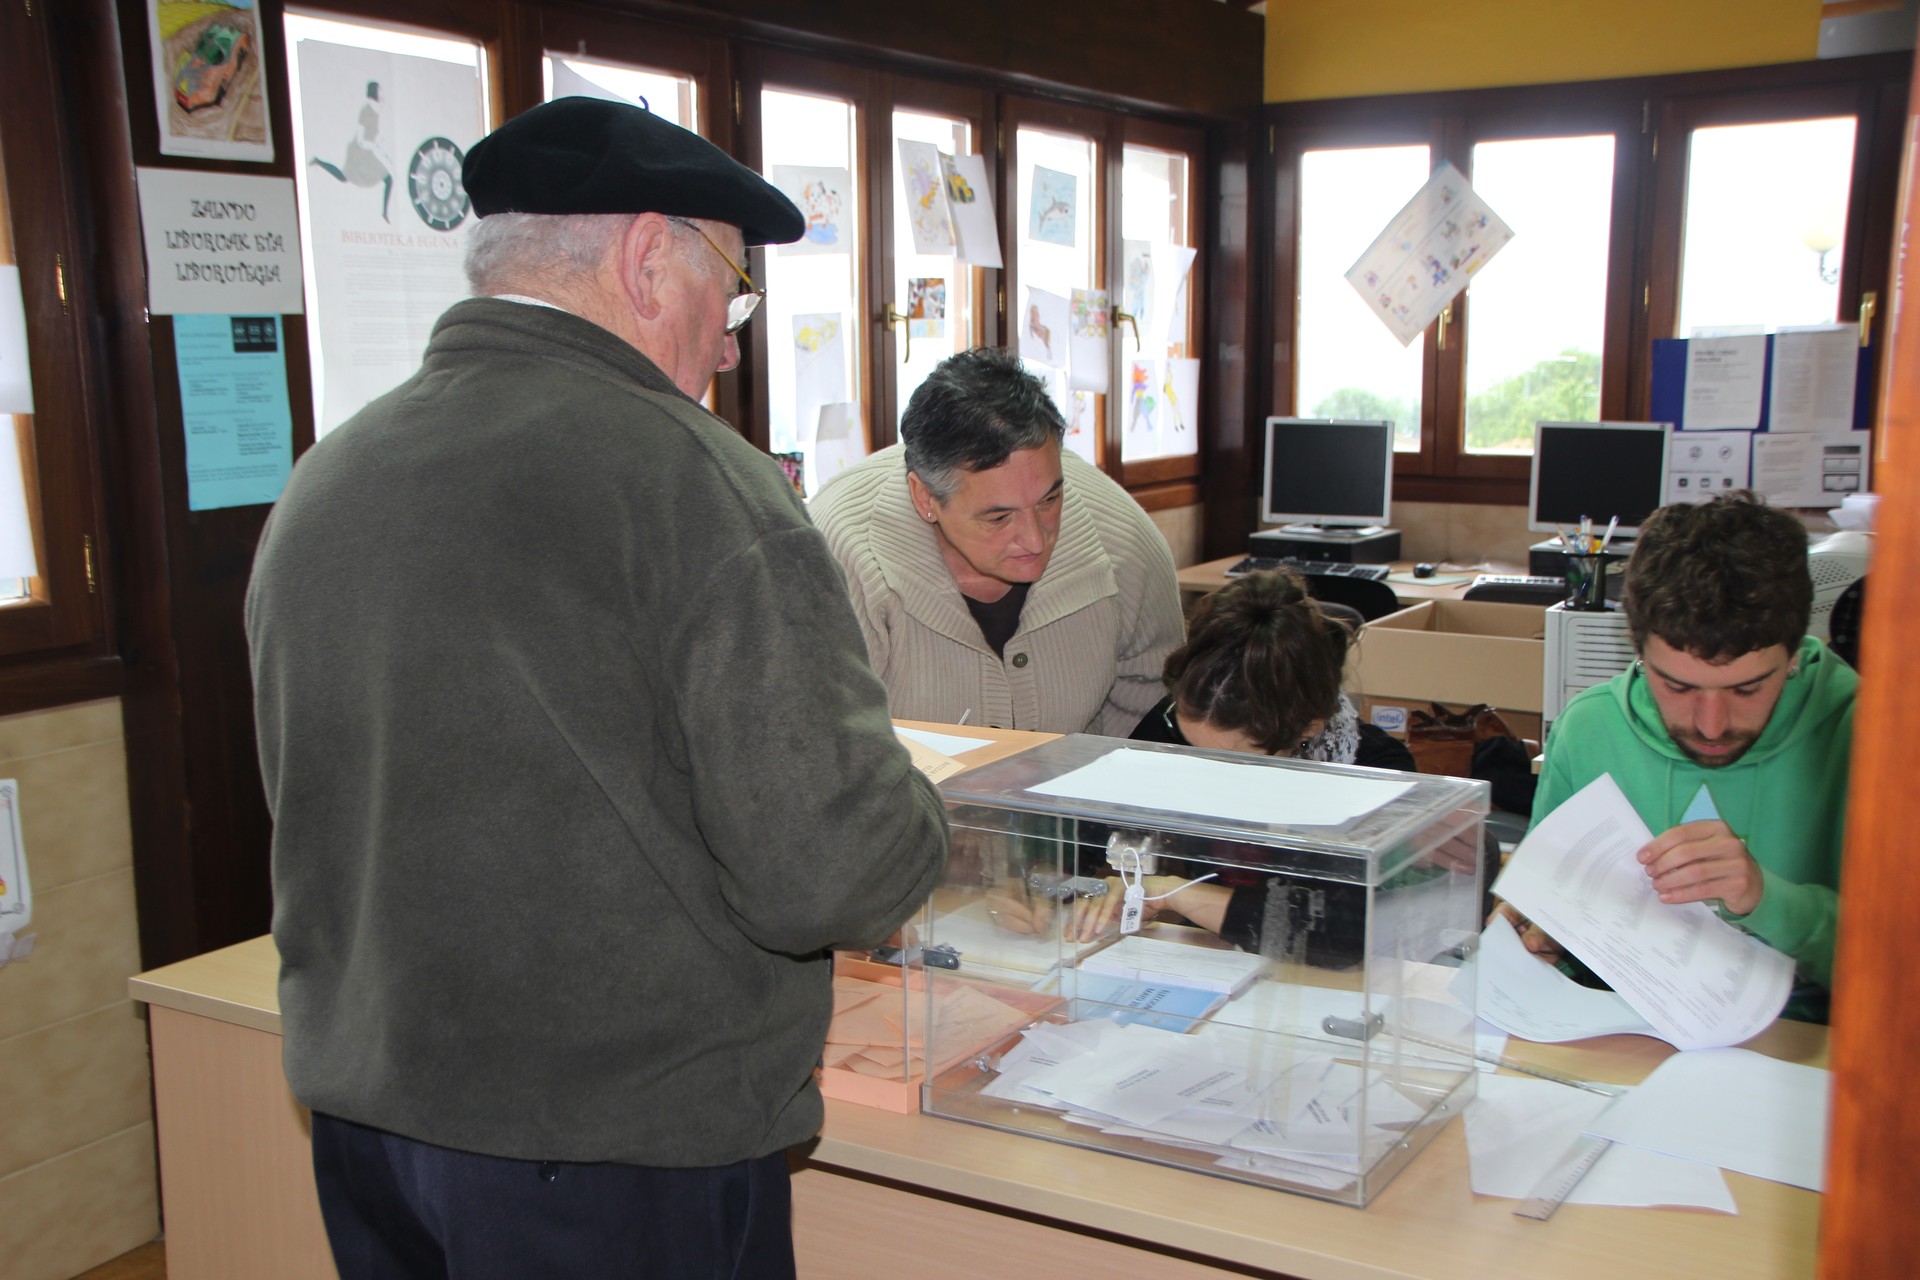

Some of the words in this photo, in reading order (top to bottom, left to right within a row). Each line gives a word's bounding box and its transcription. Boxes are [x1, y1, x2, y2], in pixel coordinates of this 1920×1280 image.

[190, 199, 256, 221] ZAINDU
[165, 229, 251, 253] LIBURUAK
[254, 232, 285, 252] ETA
[175, 260, 282, 286] LIBURUTEGIA
